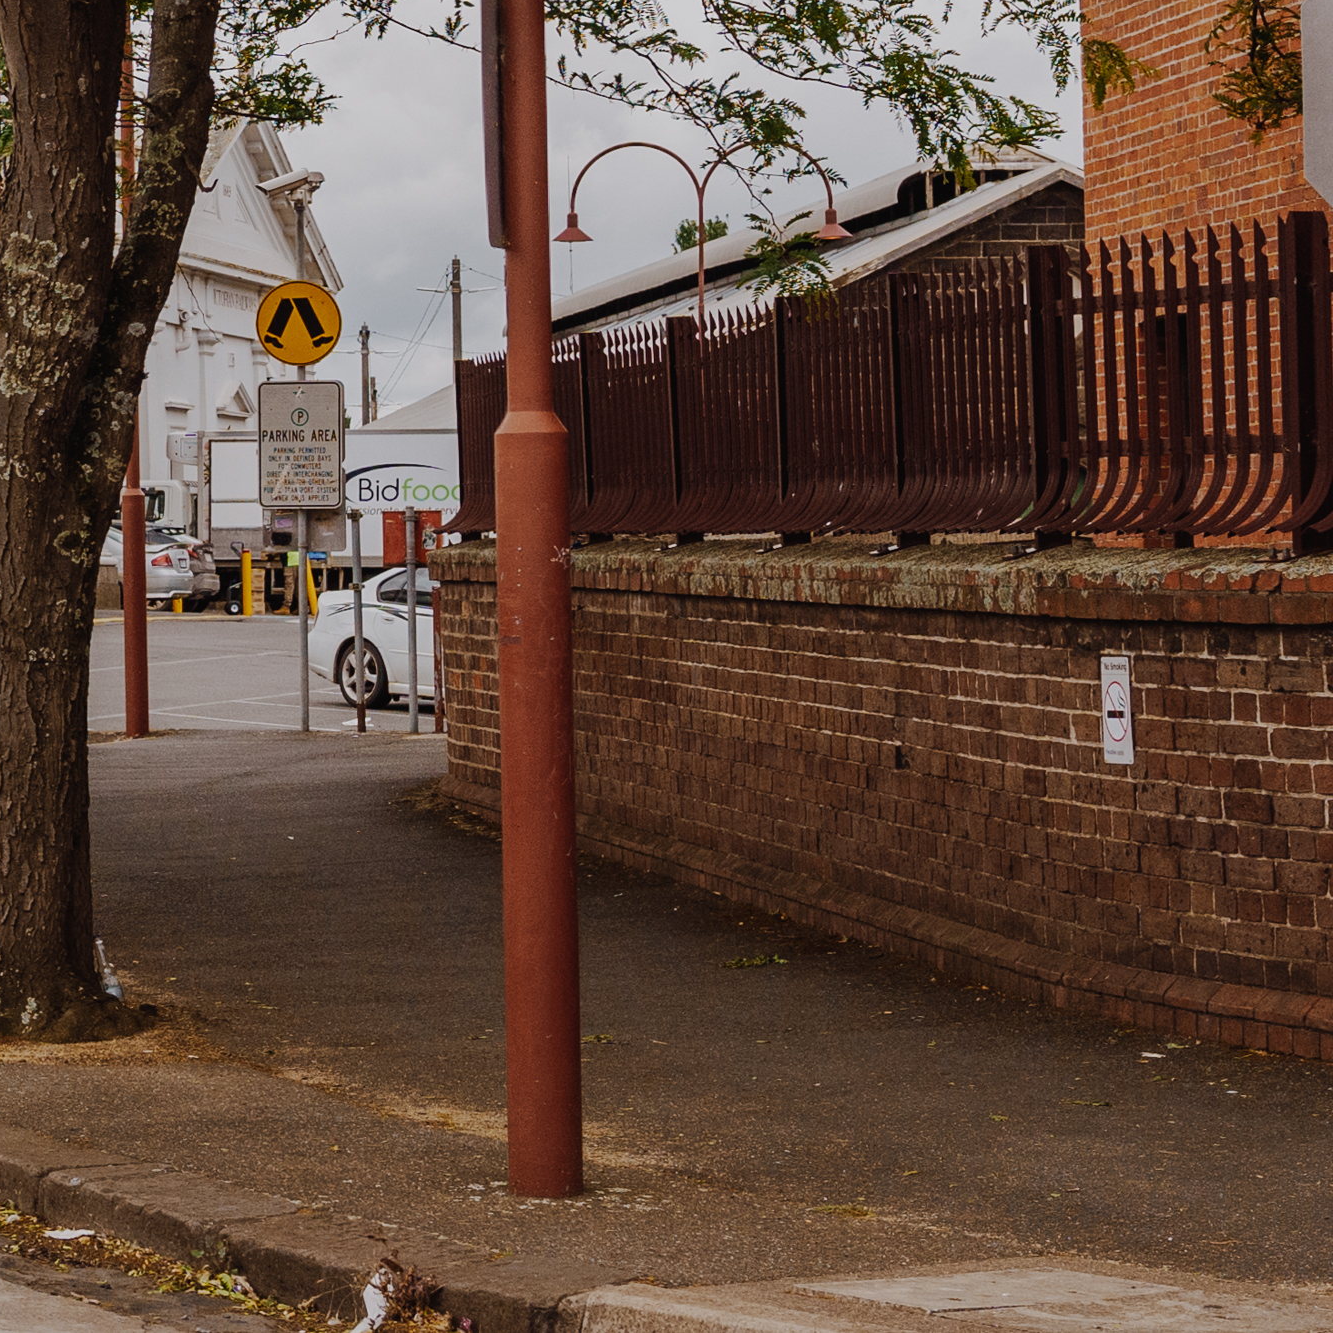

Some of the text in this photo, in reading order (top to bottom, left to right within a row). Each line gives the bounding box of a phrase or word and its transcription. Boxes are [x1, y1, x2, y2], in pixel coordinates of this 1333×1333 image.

[297, 411, 304, 424] P
[262, 429, 337, 442] PARKING AREA
[1103, 662, 1127, 673] No Smoking
